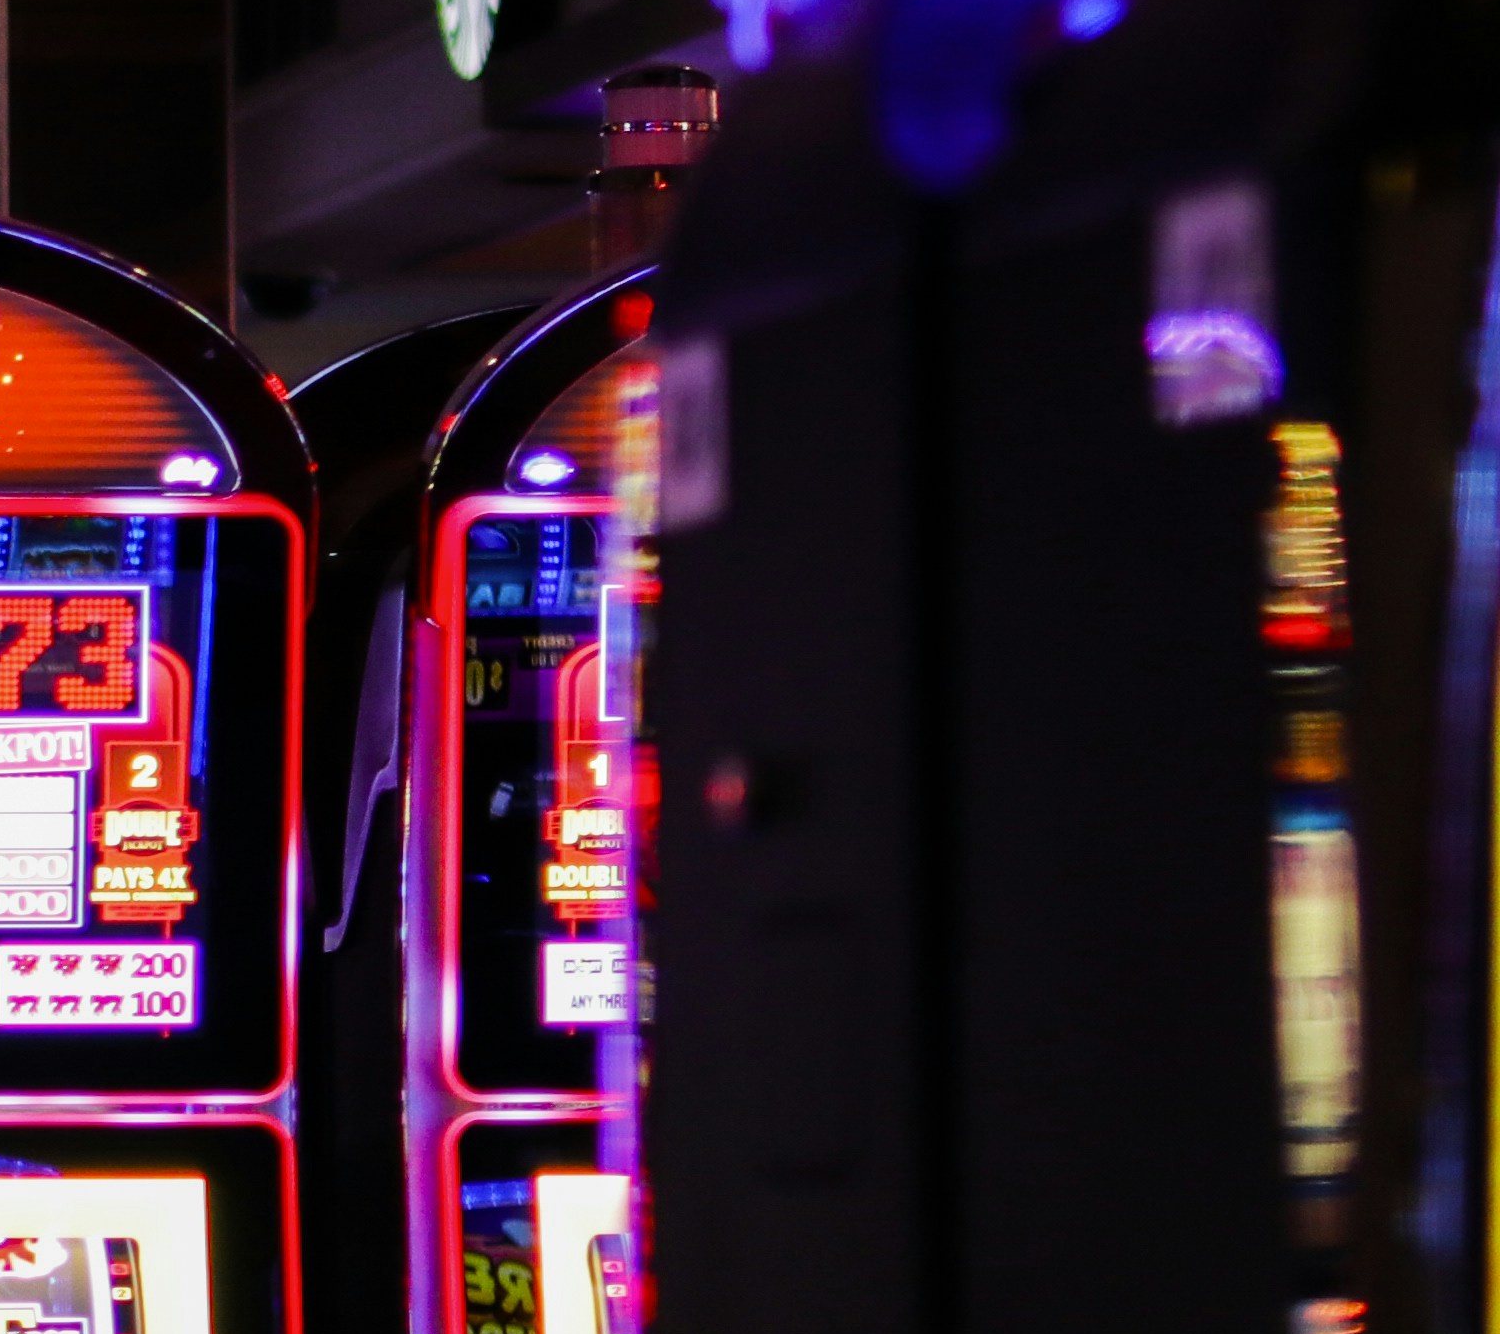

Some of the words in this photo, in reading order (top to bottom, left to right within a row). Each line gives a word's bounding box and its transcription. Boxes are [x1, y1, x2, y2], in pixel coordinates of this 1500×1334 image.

[128, 754, 159, 788] 2
[588, 753, 609, 787] 1
[96, 866, 155, 889] PAYS
[157, 866, 188, 889] 4X
[548, 866, 627, 889] DOUBL
[130, 952, 188, 979] 200
[130, 991, 187, 1017] 100
[571, 995, 595, 1010] ANY
